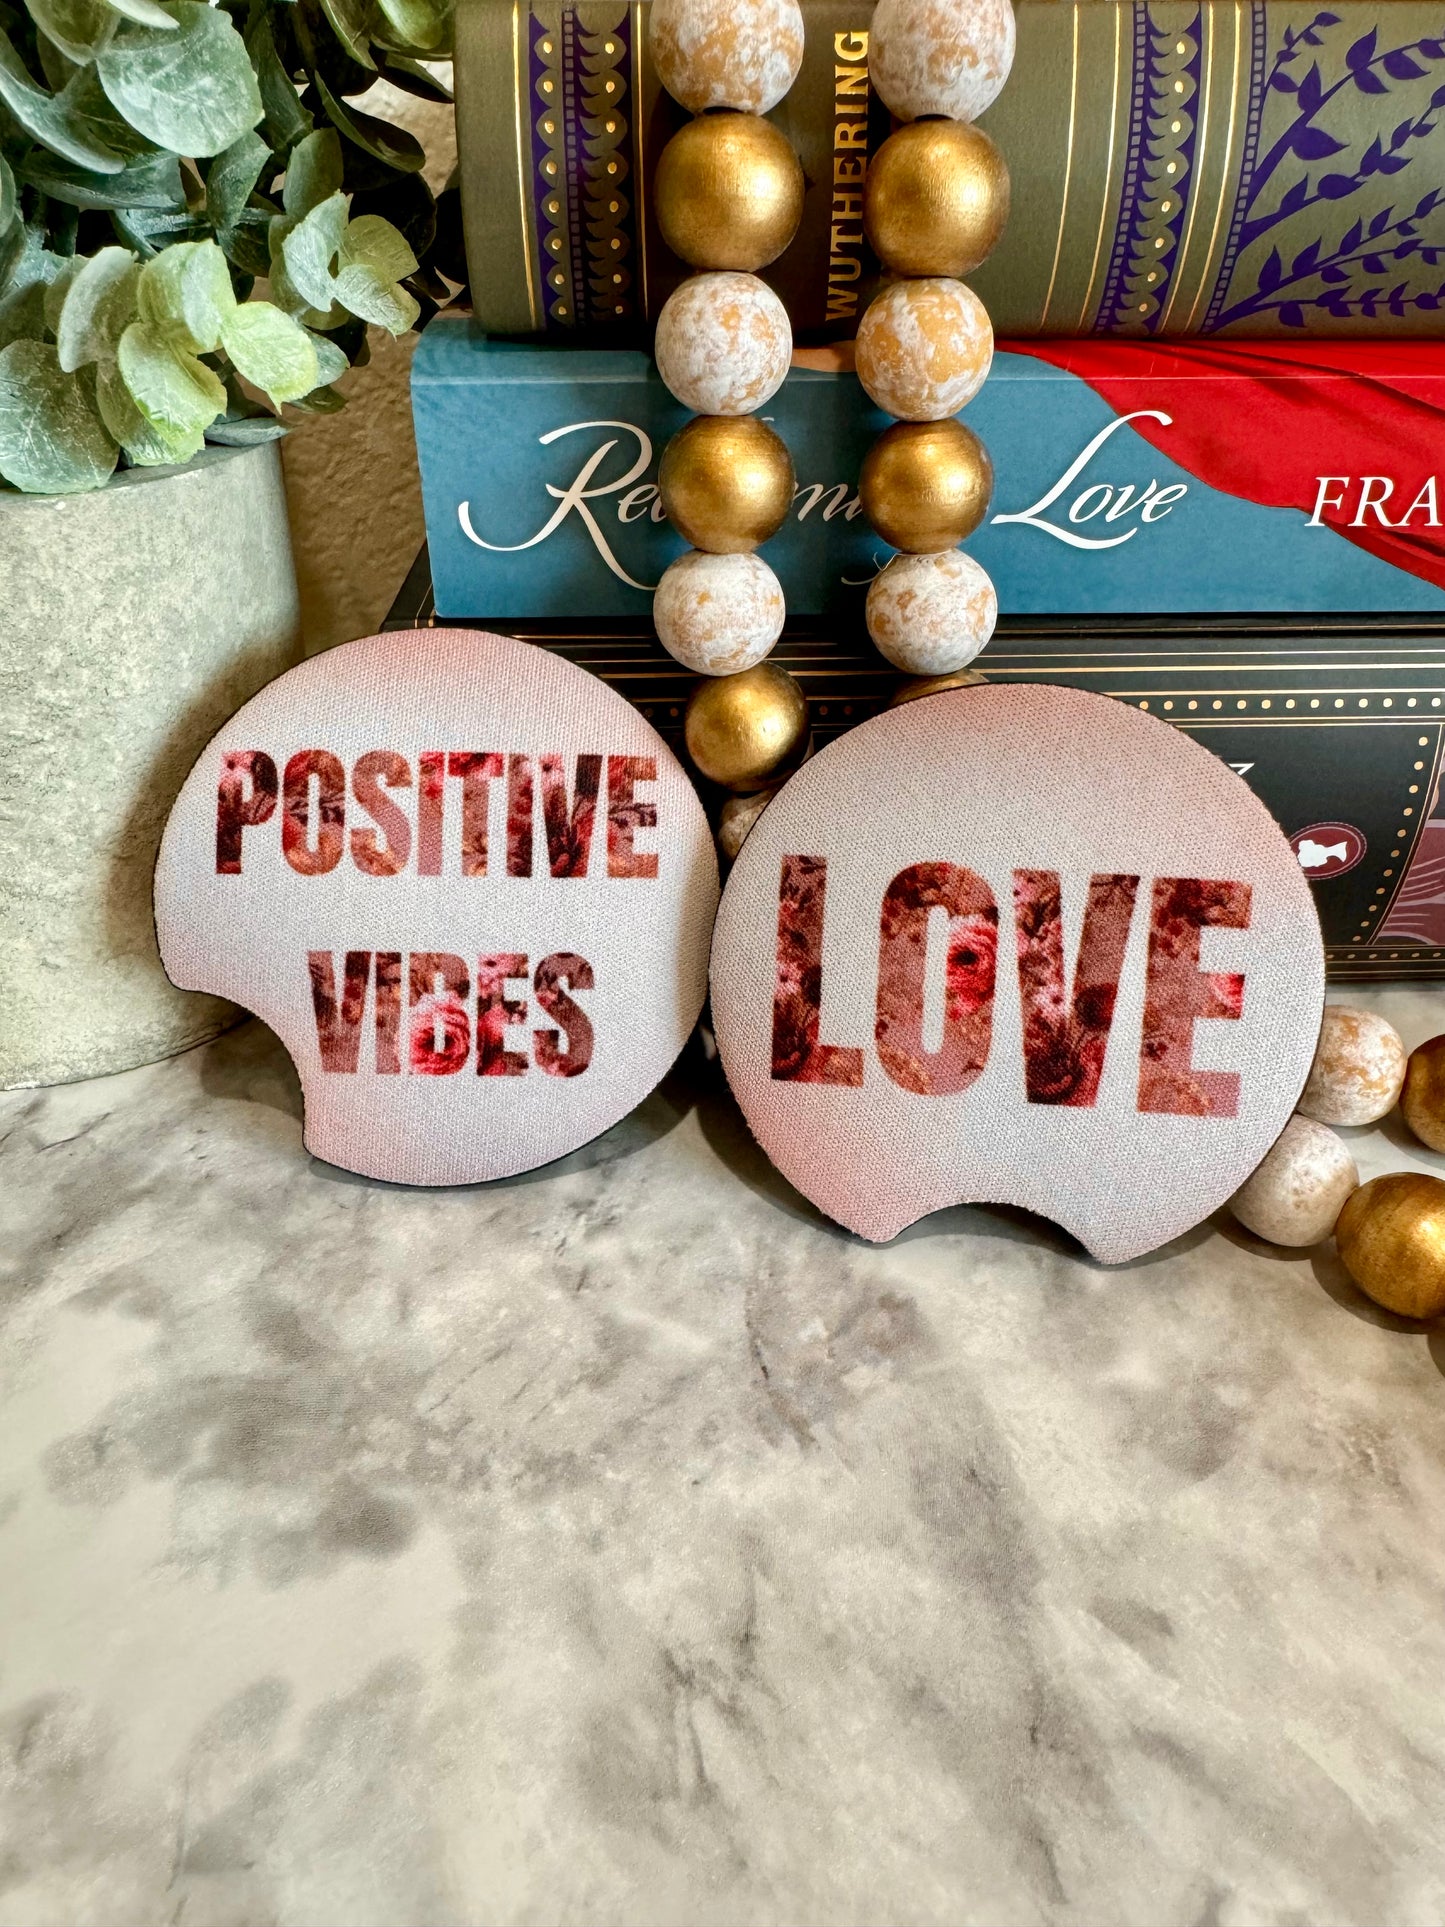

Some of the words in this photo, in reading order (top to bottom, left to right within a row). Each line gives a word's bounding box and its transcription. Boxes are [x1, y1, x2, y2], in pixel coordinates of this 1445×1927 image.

[825, 31, 869, 321] WUTHERING
[990, 410, 1188, 550] Love
[215, 749, 659, 879] POSITIVE
[307, 950, 596, 1077] VIBES
[770, 854, 1253, 1119] LOVE
